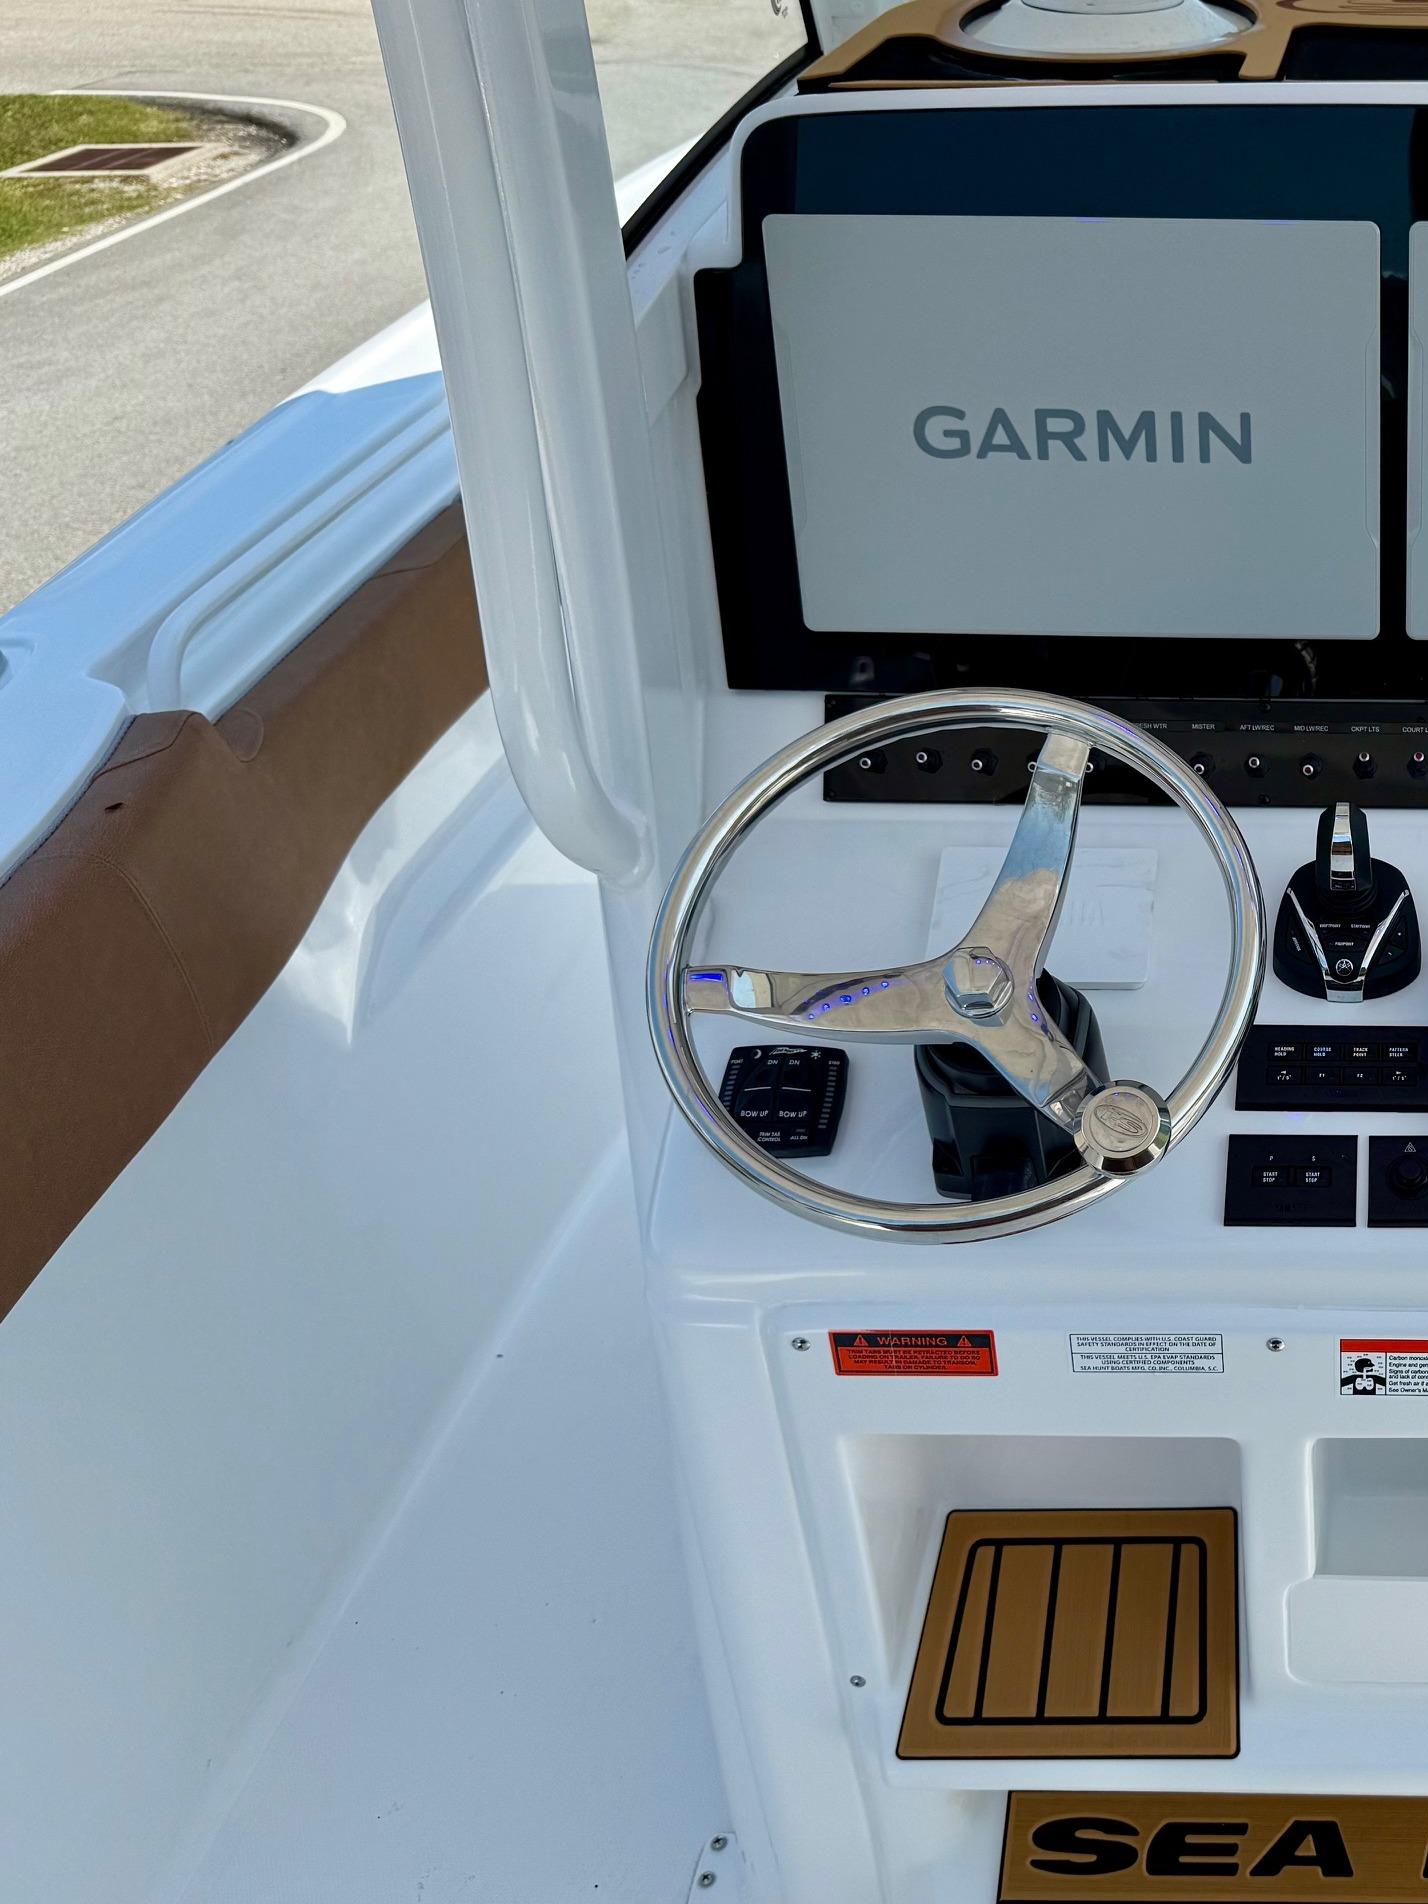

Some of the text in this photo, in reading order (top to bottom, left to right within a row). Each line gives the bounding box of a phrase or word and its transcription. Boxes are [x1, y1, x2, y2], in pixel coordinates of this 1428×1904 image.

[913, 405, 1252, 464] GARMIN
[877, 1337, 947, 1345] WARNING
[1031, 1818, 1353, 1877] SEA
